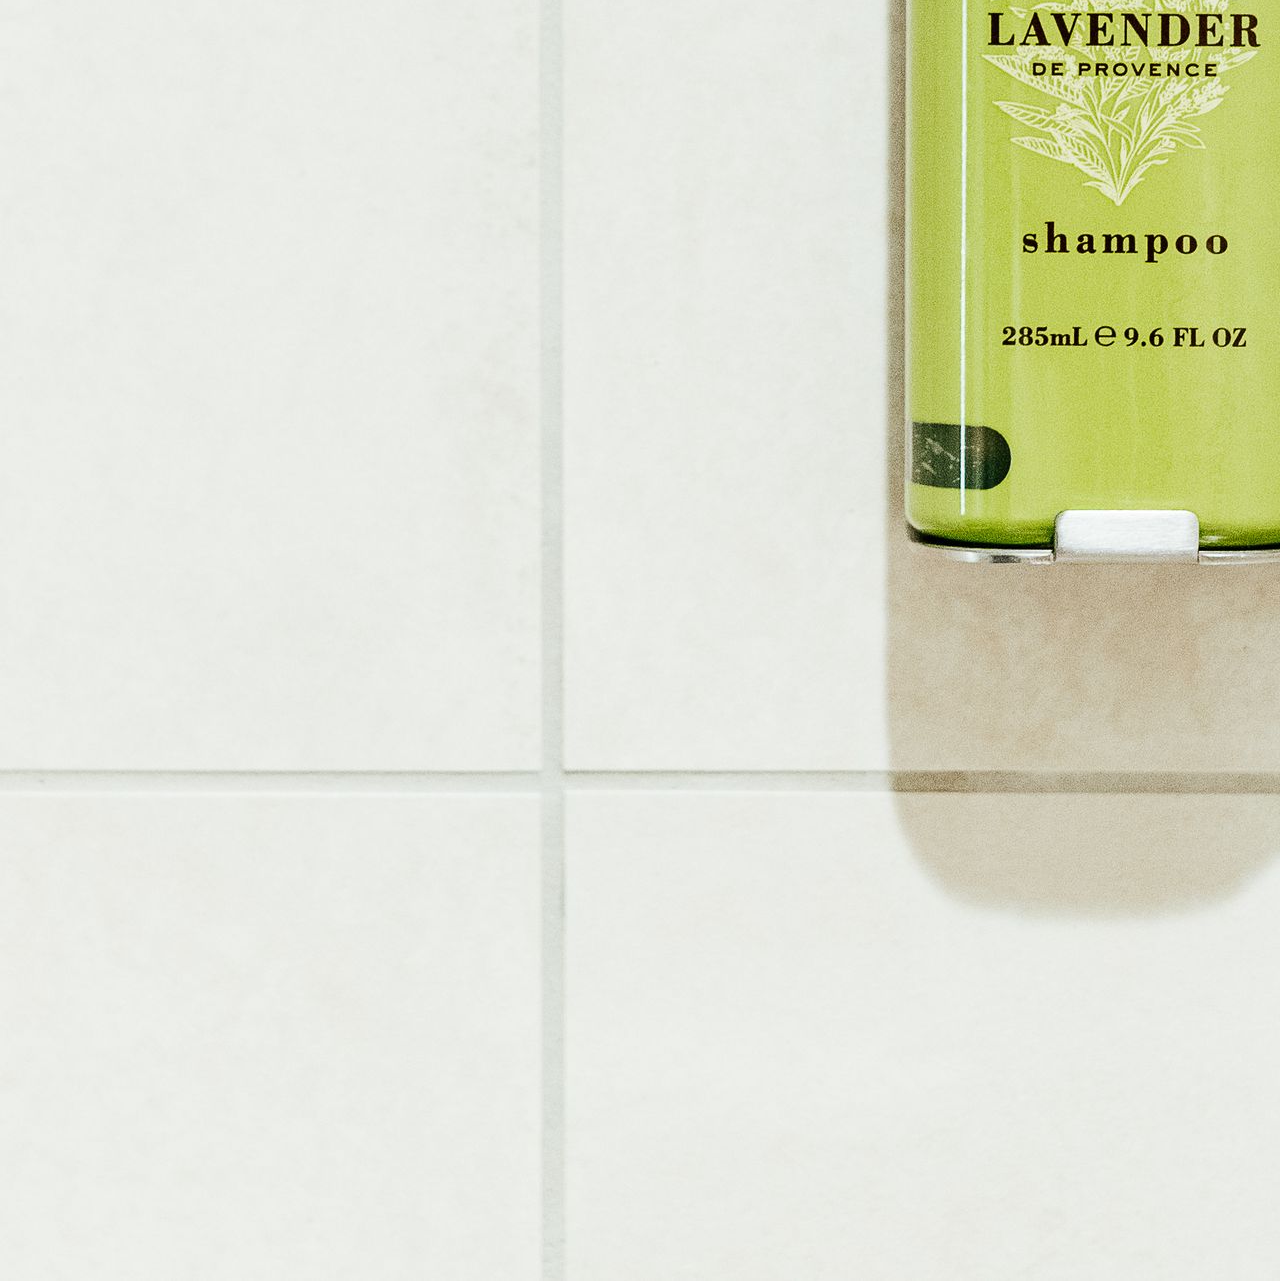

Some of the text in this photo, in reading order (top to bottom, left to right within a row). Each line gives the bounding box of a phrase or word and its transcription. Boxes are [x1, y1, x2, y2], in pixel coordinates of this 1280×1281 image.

[987, 11, 1261, 48] LAVENDER
[1032, 62, 1217, 78] DE PROVENCE
[1022, 220, 1229, 264] shampoo
[1001, 325, 1088, 347] 285mL
[1123, 327, 1165, 348] 9.6
[1172, 327, 1206, 348] FL
[1212, 327, 1247, 348] OZ
